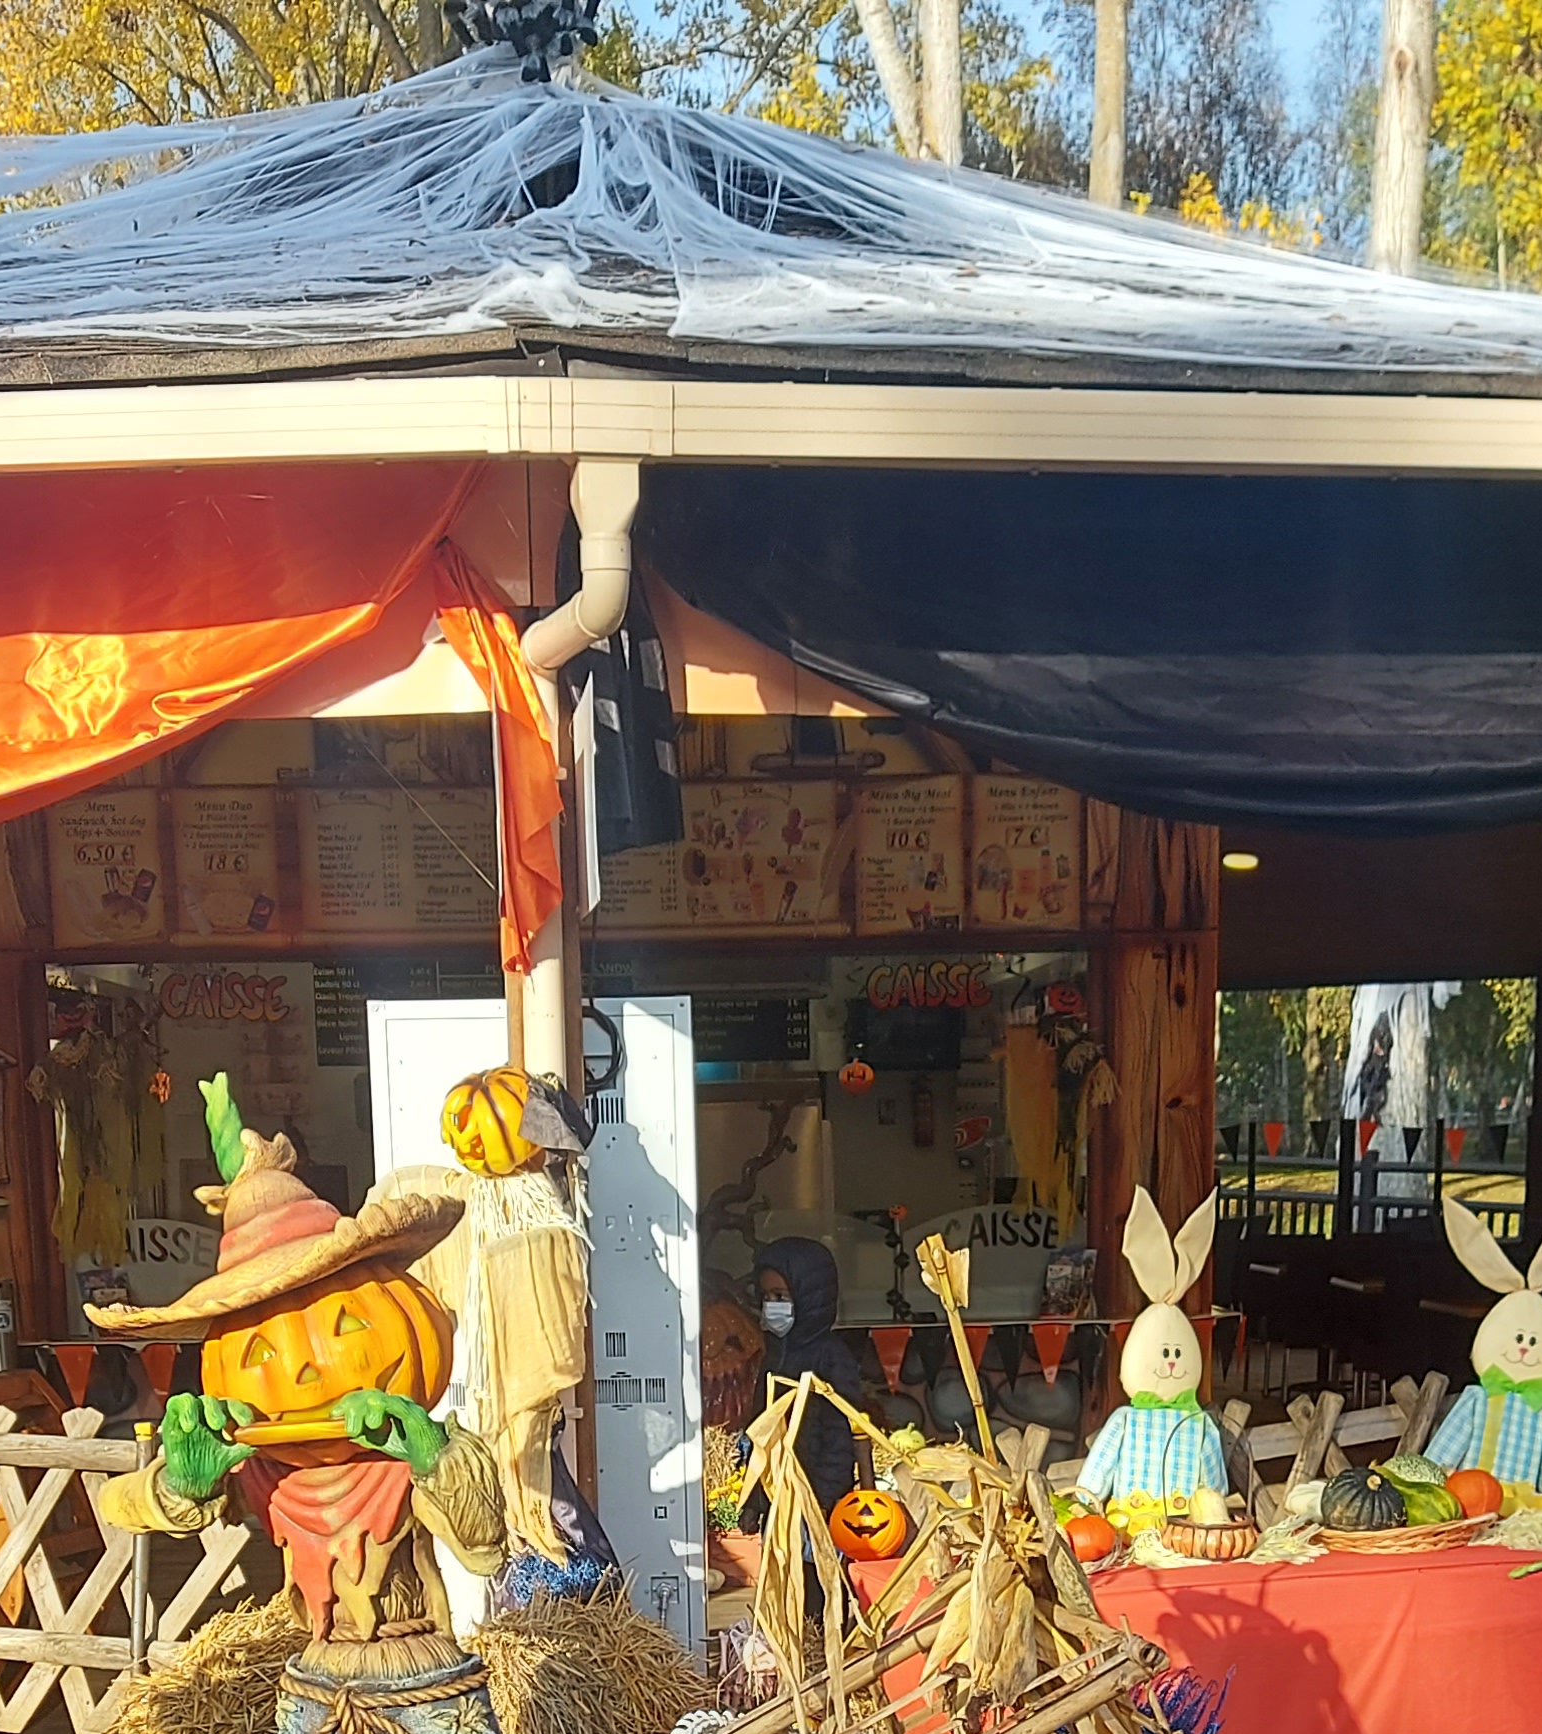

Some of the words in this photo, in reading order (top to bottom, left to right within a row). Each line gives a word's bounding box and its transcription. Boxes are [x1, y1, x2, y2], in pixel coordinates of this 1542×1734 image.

[869, 790, 899, 801] Menu
[901, 790, 921, 802] Big
[988, 787, 1017, 797] Menu
[1020, 785, 1059, 799] Enfant
[84, 801, 116, 812] Menu
[194, 800, 226, 811] Menu
[229, 800, 253, 811] Duo
[129, 815, 146, 828] dog
[66, 828, 92, 840] Chips
[890, 831, 909, 848] 10
[915, 831, 927, 849] €
[1014, 828, 1023, 845] 7
[1030, 828, 1042, 845] €
[77, 844, 115, 862] 6,50
[121, 844, 133, 861] €
[209, 854, 227, 871] 18
[233, 854, 246, 872] €
[865, 961, 993, 1010] CAISSE
[160, 972, 290, 1022] CAISSE
